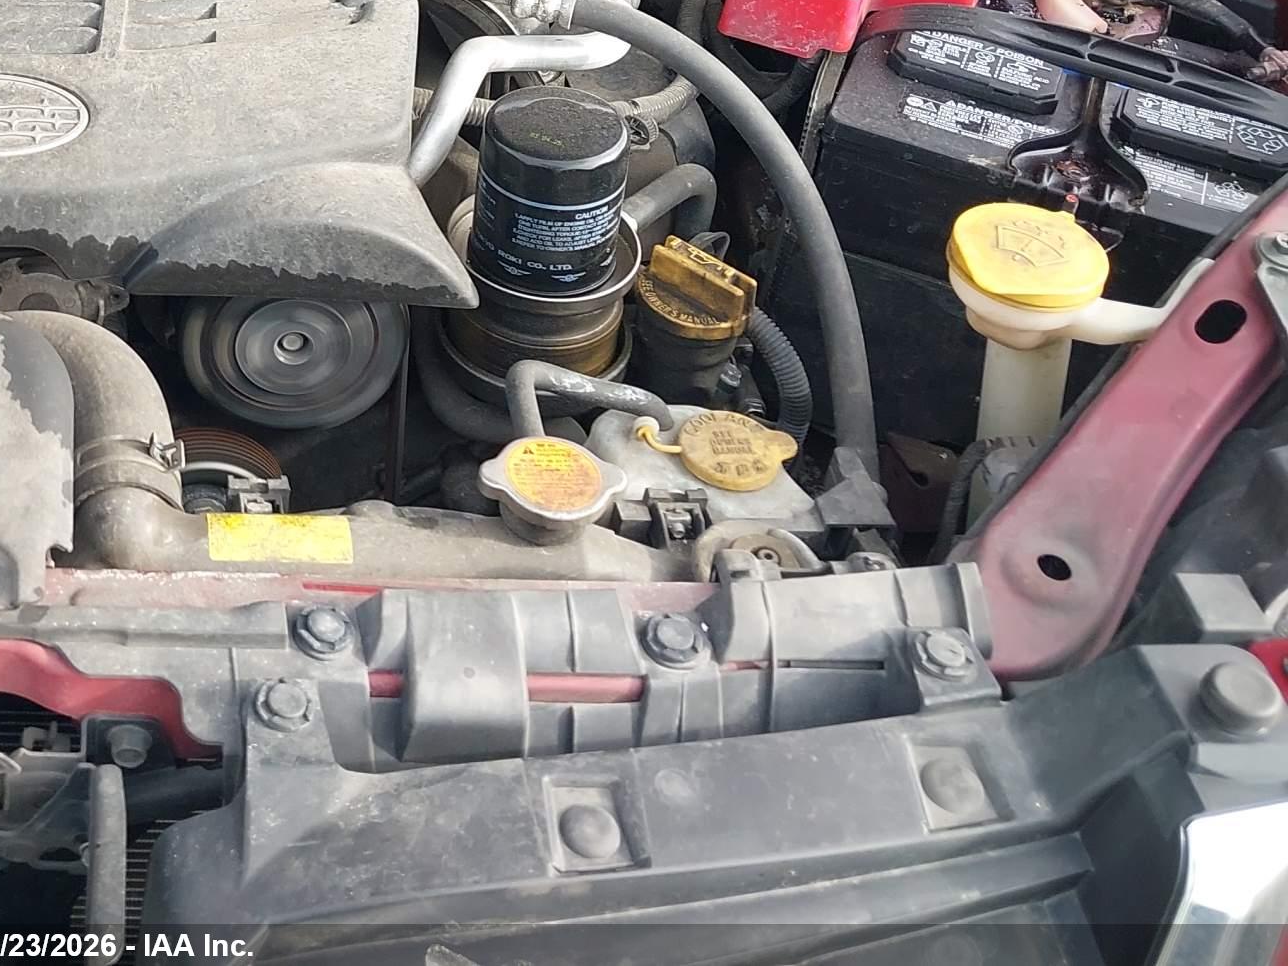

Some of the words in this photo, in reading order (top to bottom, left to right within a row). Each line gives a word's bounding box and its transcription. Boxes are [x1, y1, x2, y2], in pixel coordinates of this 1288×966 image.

[931, 30, 984, 50] DANGER
[996, 47, 1044, 68] POISON
[957, 102, 1060, 134] DANGER/POISO
[575, 205, 610, 220] CAUTION
[497, 250, 522, 265] ROKI
[680, 312, 721, 325] MANUAL
